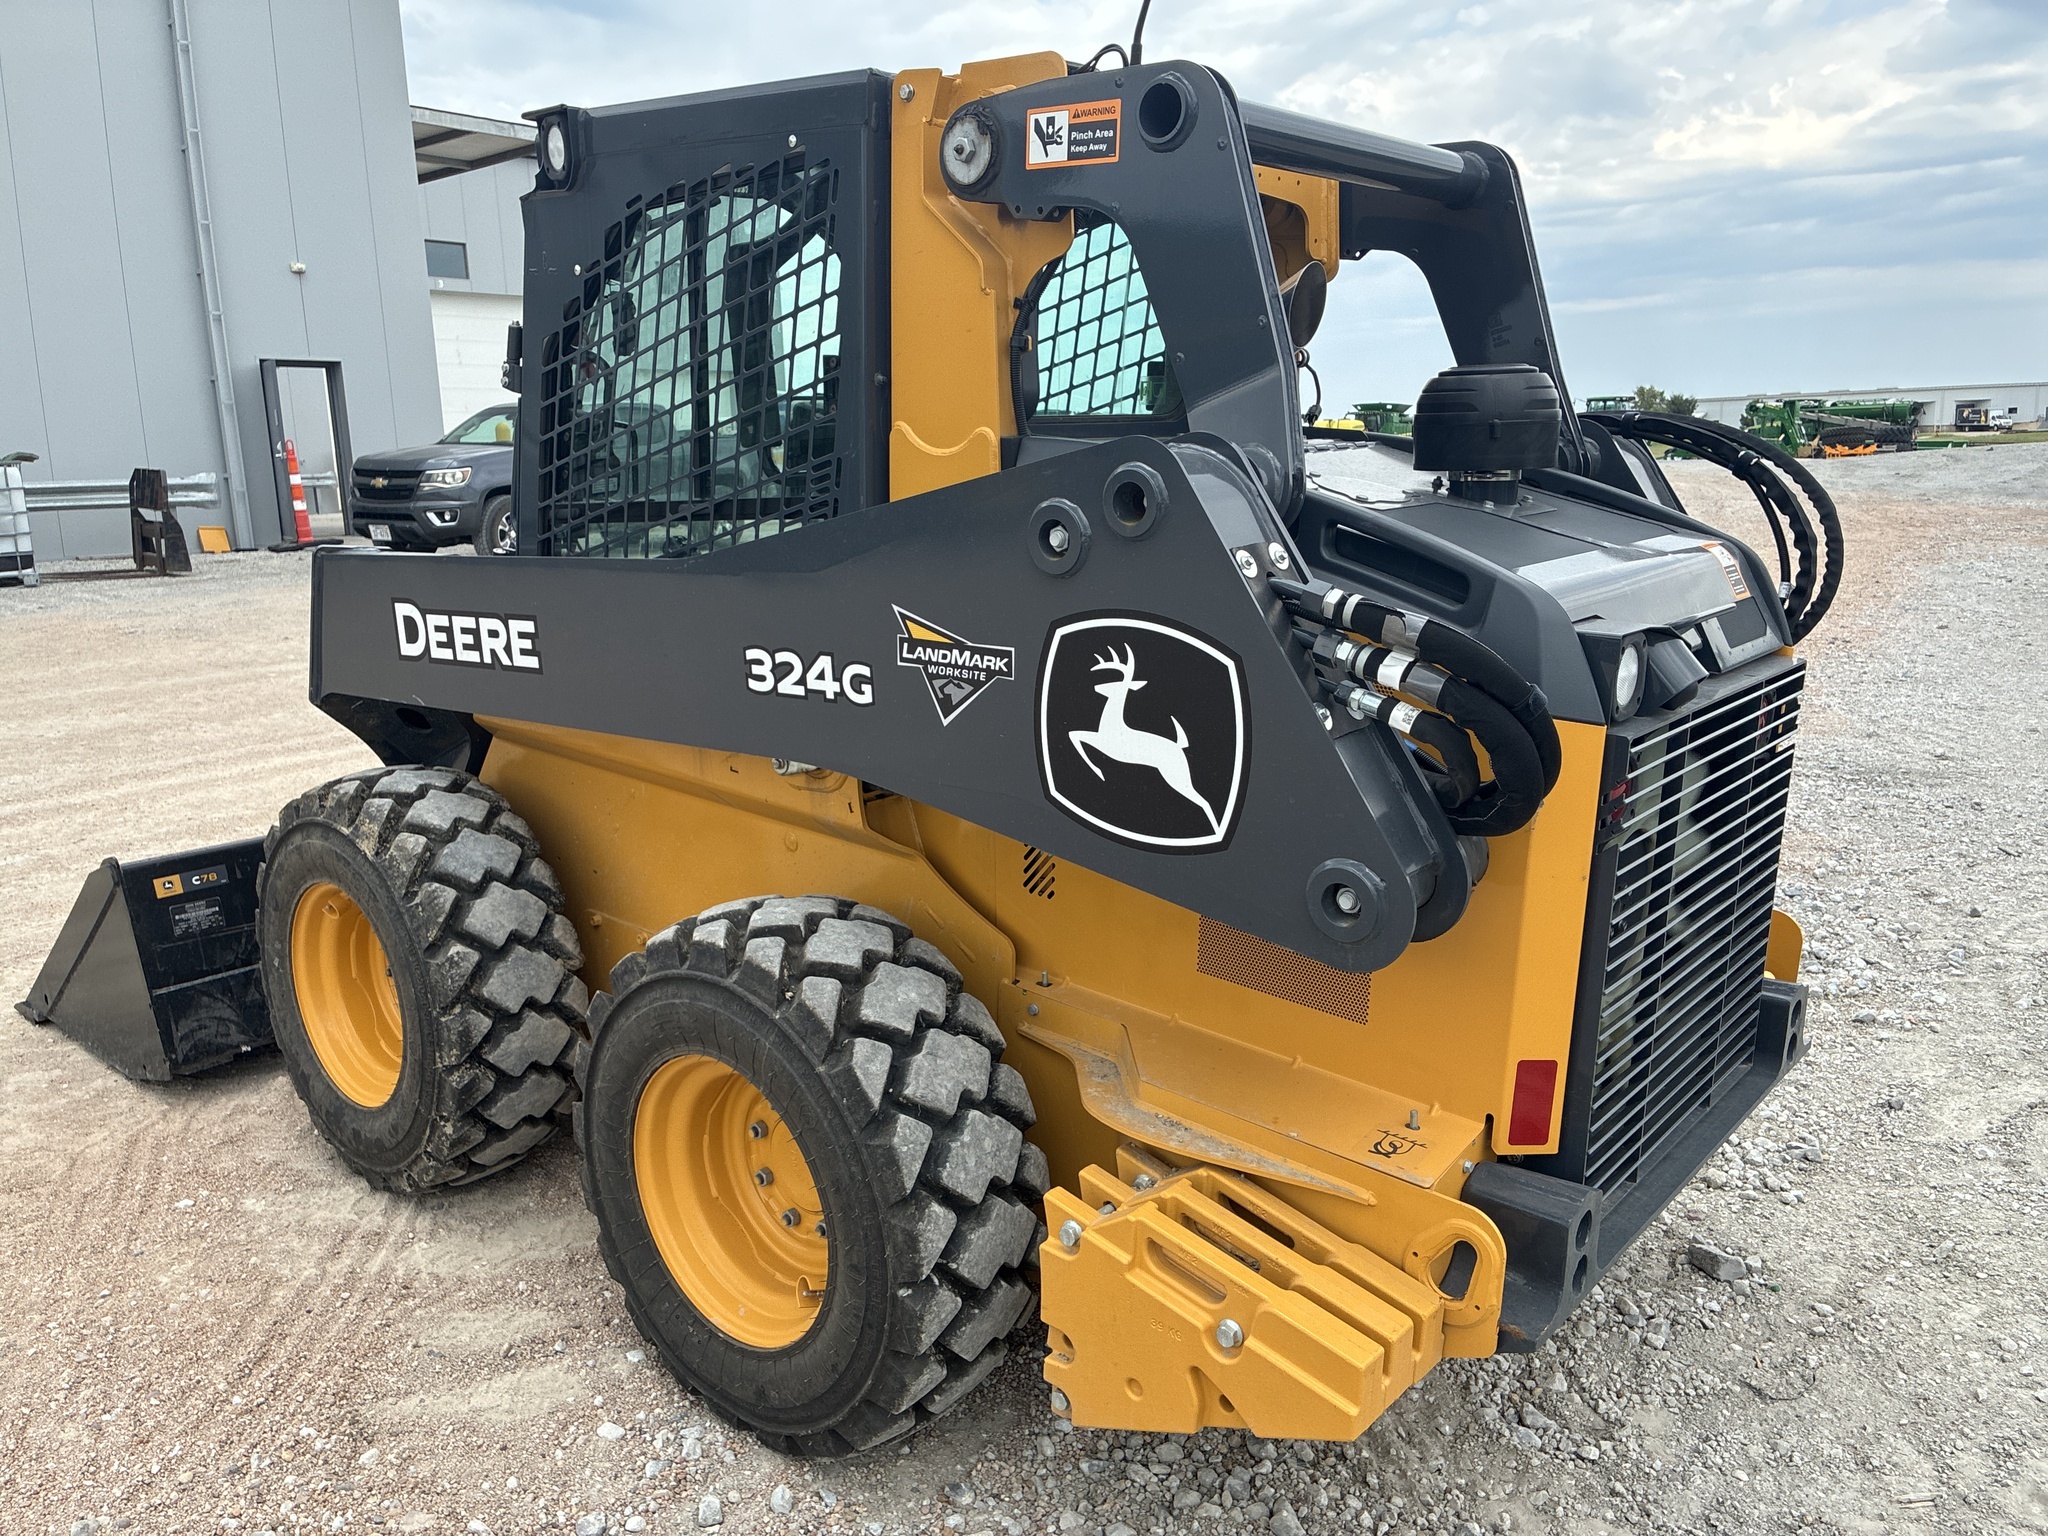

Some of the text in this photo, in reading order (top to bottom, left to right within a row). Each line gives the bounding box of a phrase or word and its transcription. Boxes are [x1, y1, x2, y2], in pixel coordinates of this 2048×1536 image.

[1080, 105, 1116, 117] WARNING
[1071, 128, 1114, 141] Pinch Area
[1070, 143, 1108, 154] Keep Away
[394, 602, 540, 669] DEERE
[902, 642, 1010, 672] LANDMARK
[745, 648, 873, 704] 324G
[927, 664, 987, 681] WORKSITE
[191, 872, 218, 885] C78
